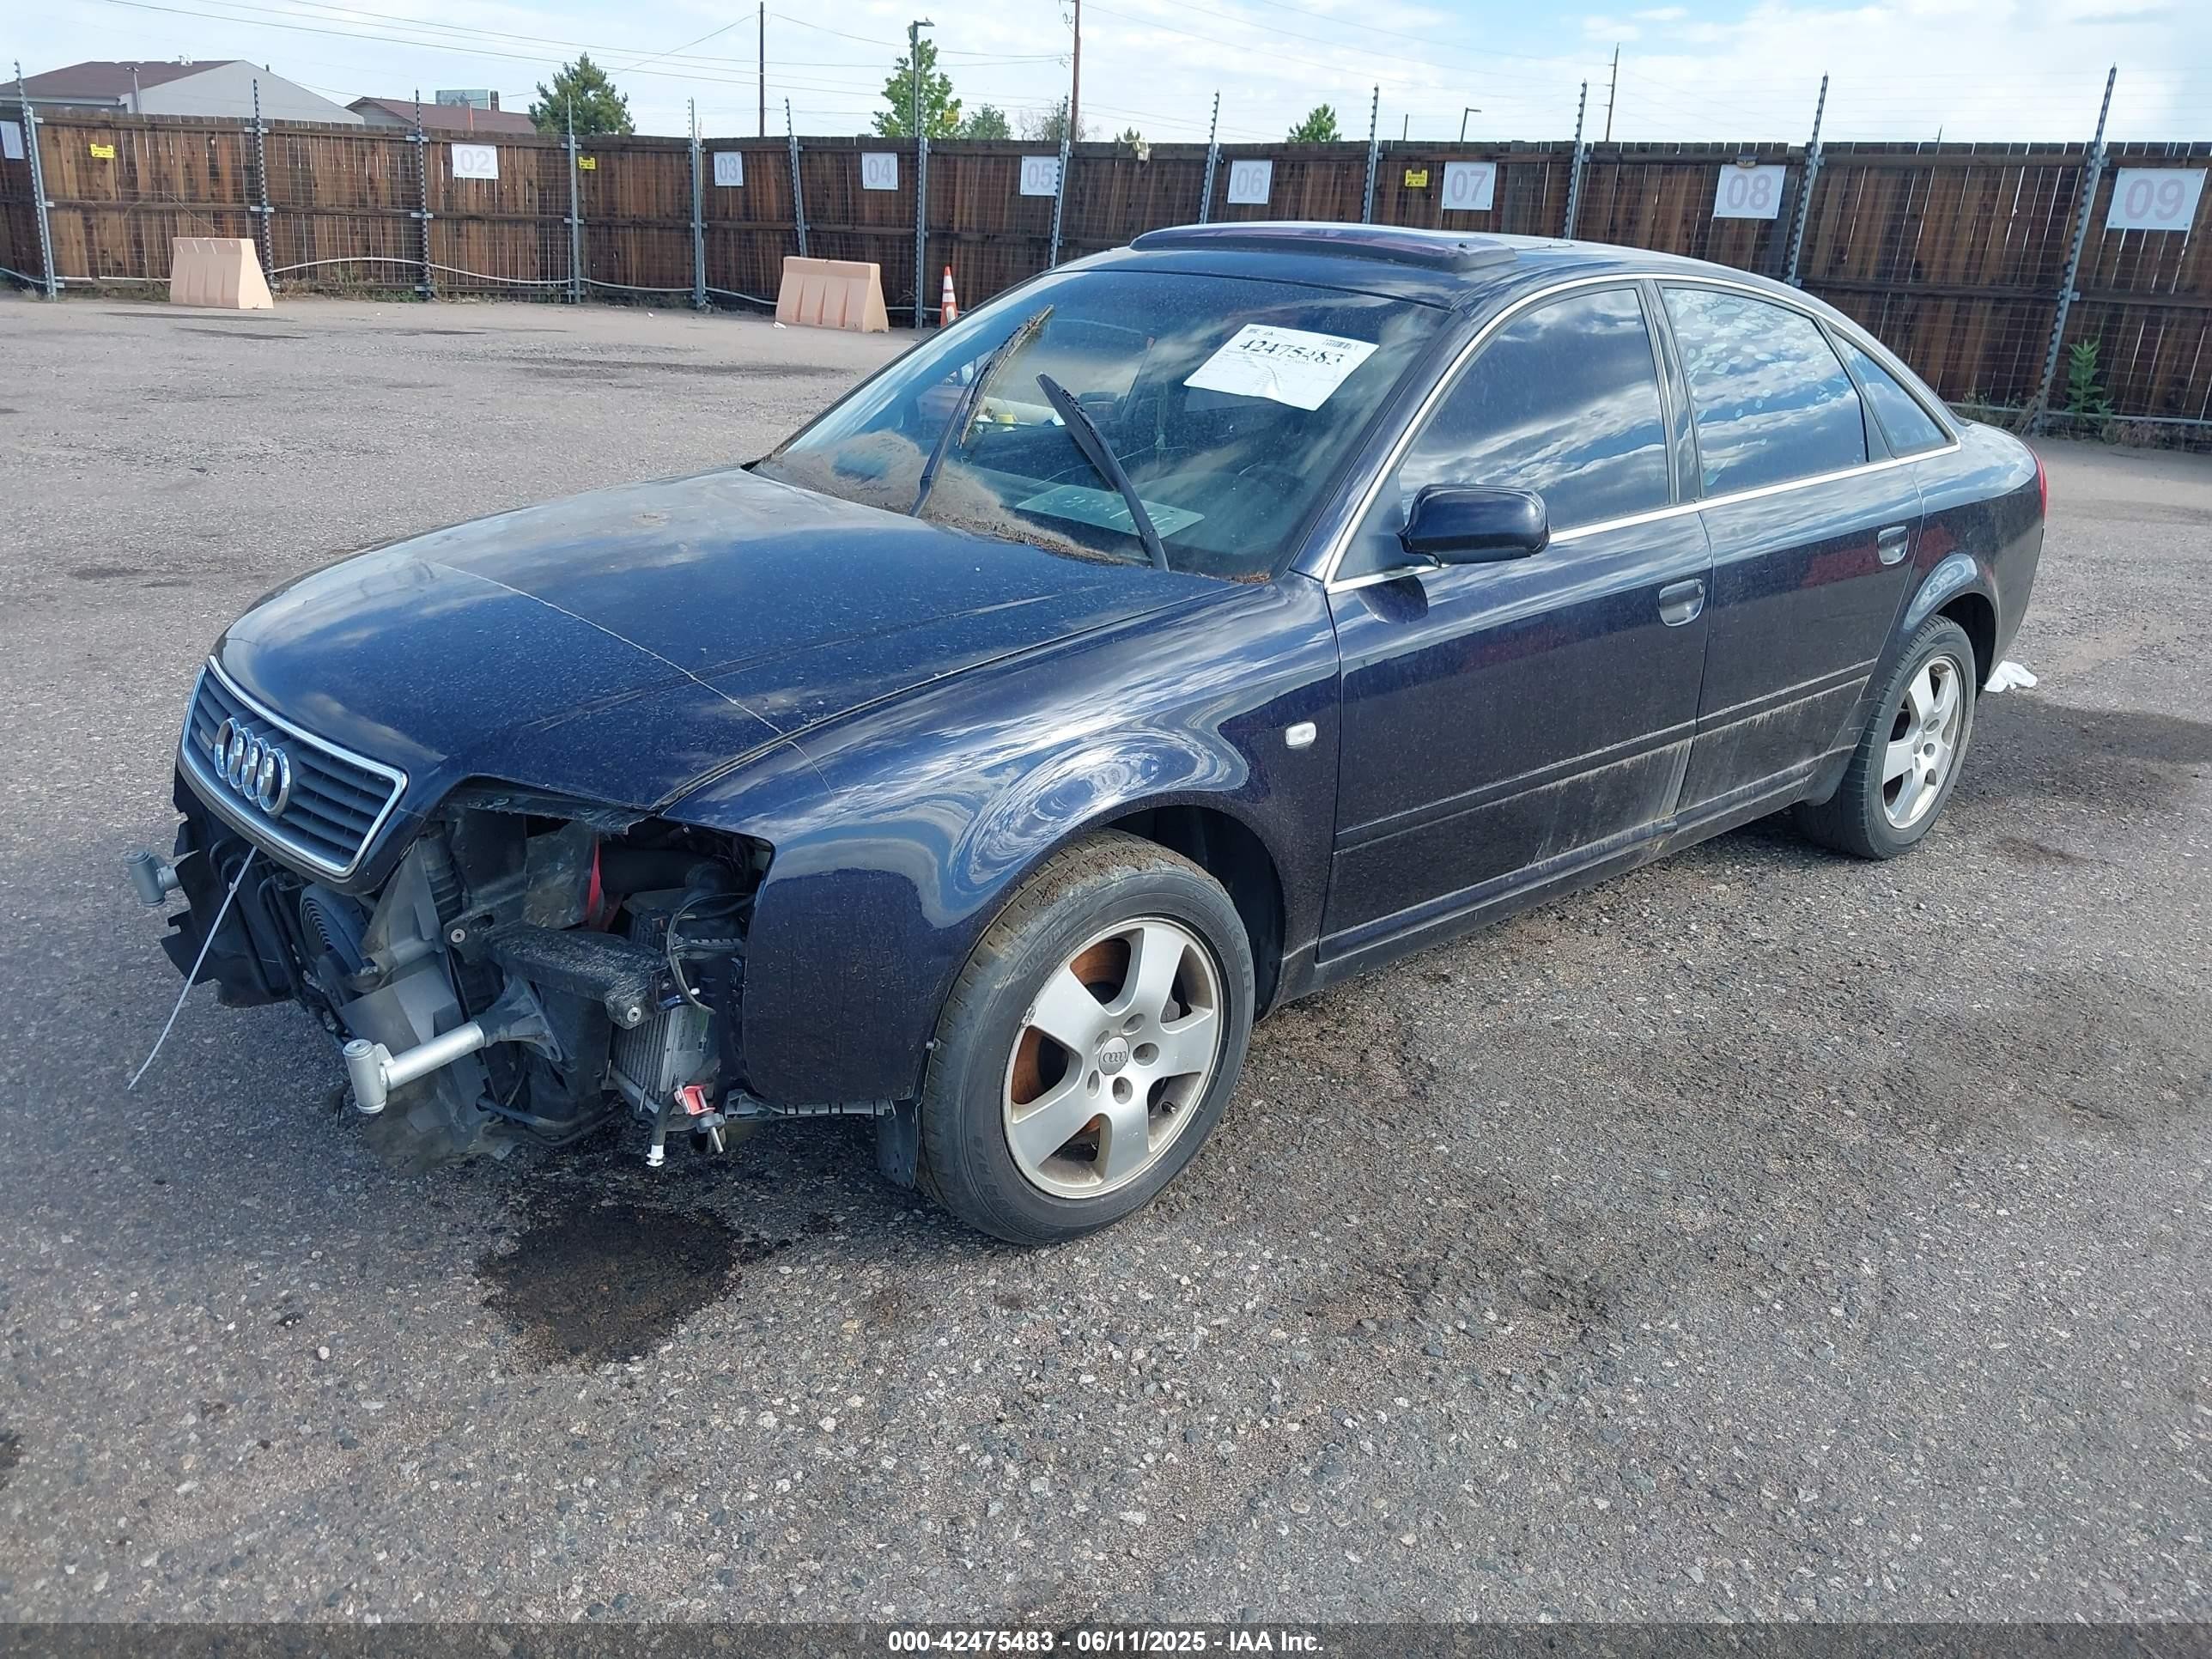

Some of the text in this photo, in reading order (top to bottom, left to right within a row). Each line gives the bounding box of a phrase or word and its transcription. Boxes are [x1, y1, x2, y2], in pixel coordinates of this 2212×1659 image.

[460, 149, 489, 173] 02
[719, 158, 738, 180] 03
[868, 160, 891, 183] 04
[1027, 163, 1053, 188] 05
[1236, 167, 1265, 197] 06
[1450, 170, 1487, 202] 07
[1727, 174, 1772, 210] 08
[2124, 179, 2185, 220] 09
